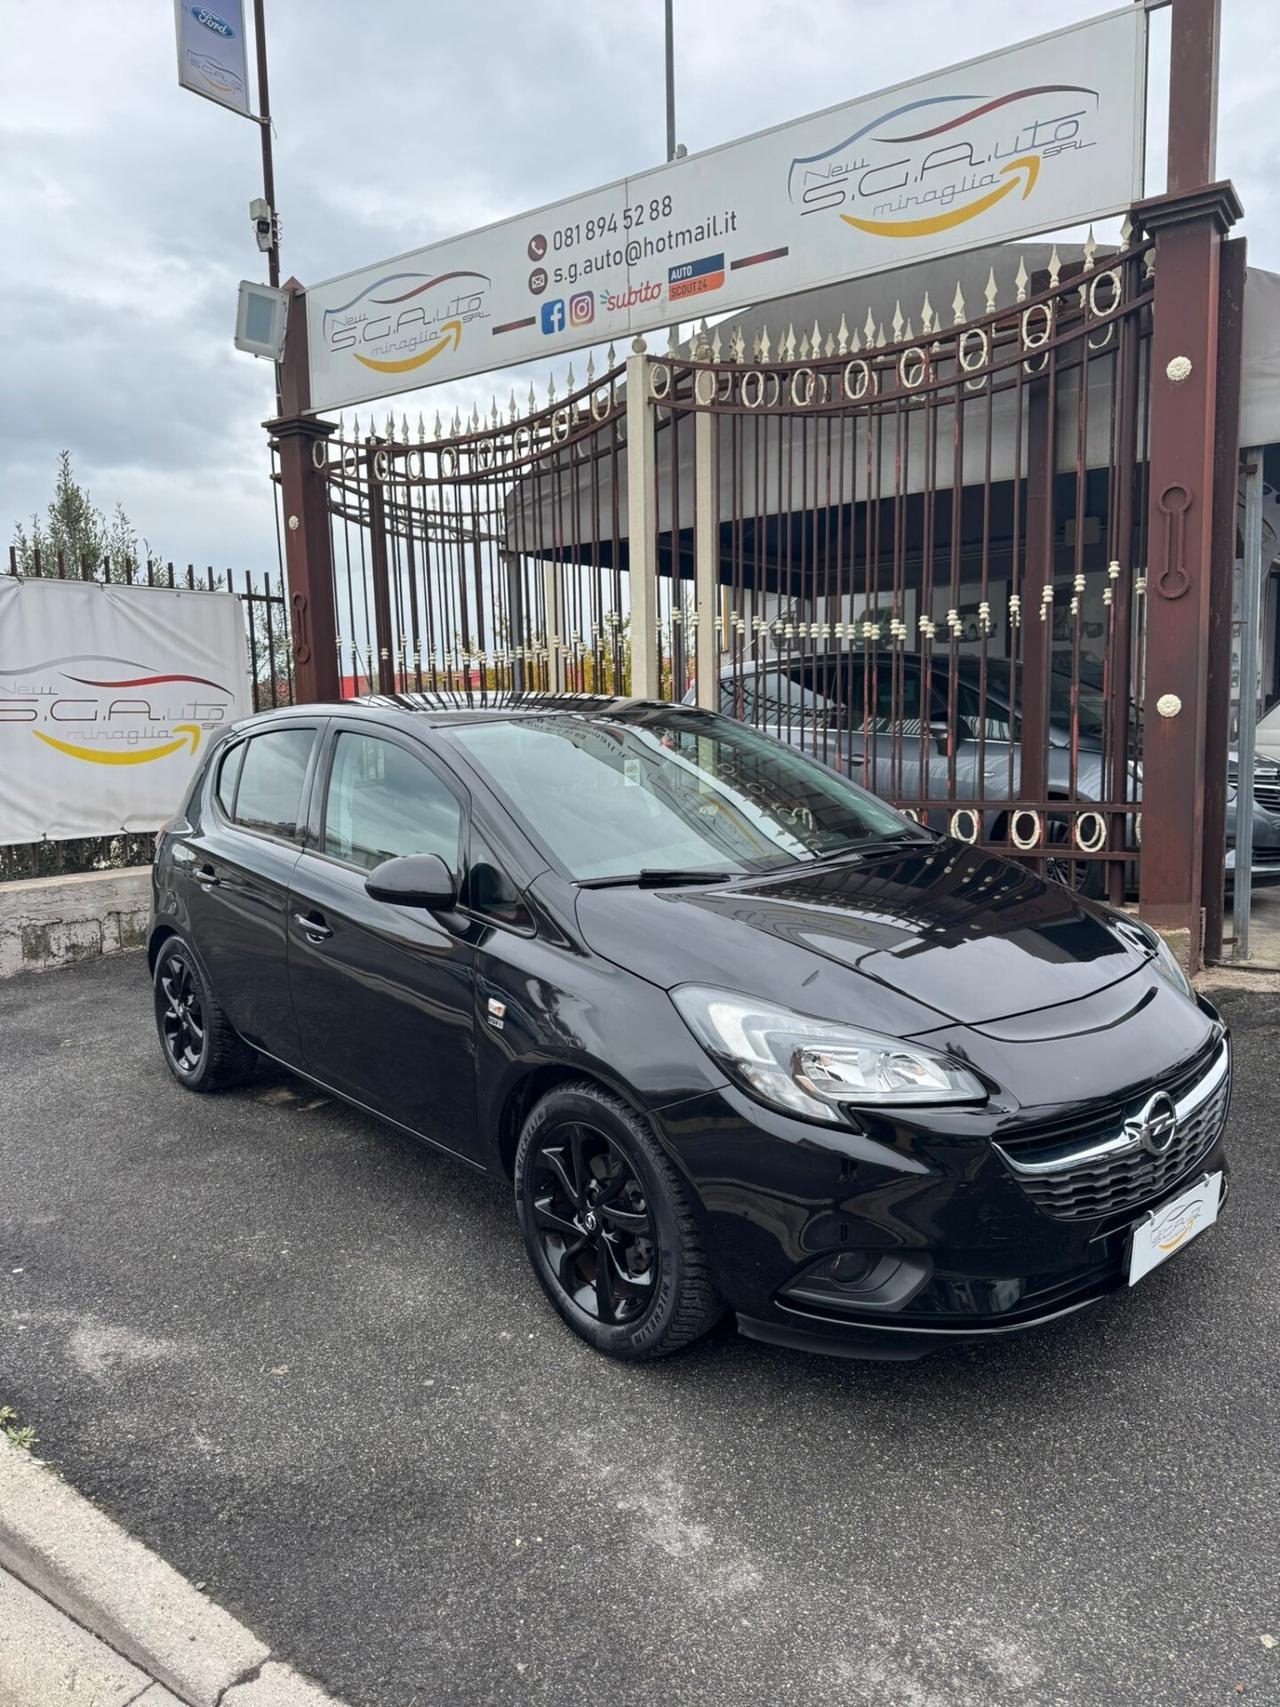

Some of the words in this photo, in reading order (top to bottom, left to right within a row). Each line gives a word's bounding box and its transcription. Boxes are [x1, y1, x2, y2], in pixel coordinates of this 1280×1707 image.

[198, 8, 228, 35] Ford
[553, 222, 581, 252] 081
[585, 212, 618, 241] 894
[623, 204, 644, 229] 52
[649, 195, 673, 222] 88
[553, 210, 738, 285] s.g.auto@hotmail.it
[671, 264, 693, 281] AUTO
[606, 280, 663, 312] subito
[634, 1281, 670, 1345] MICHELIN
